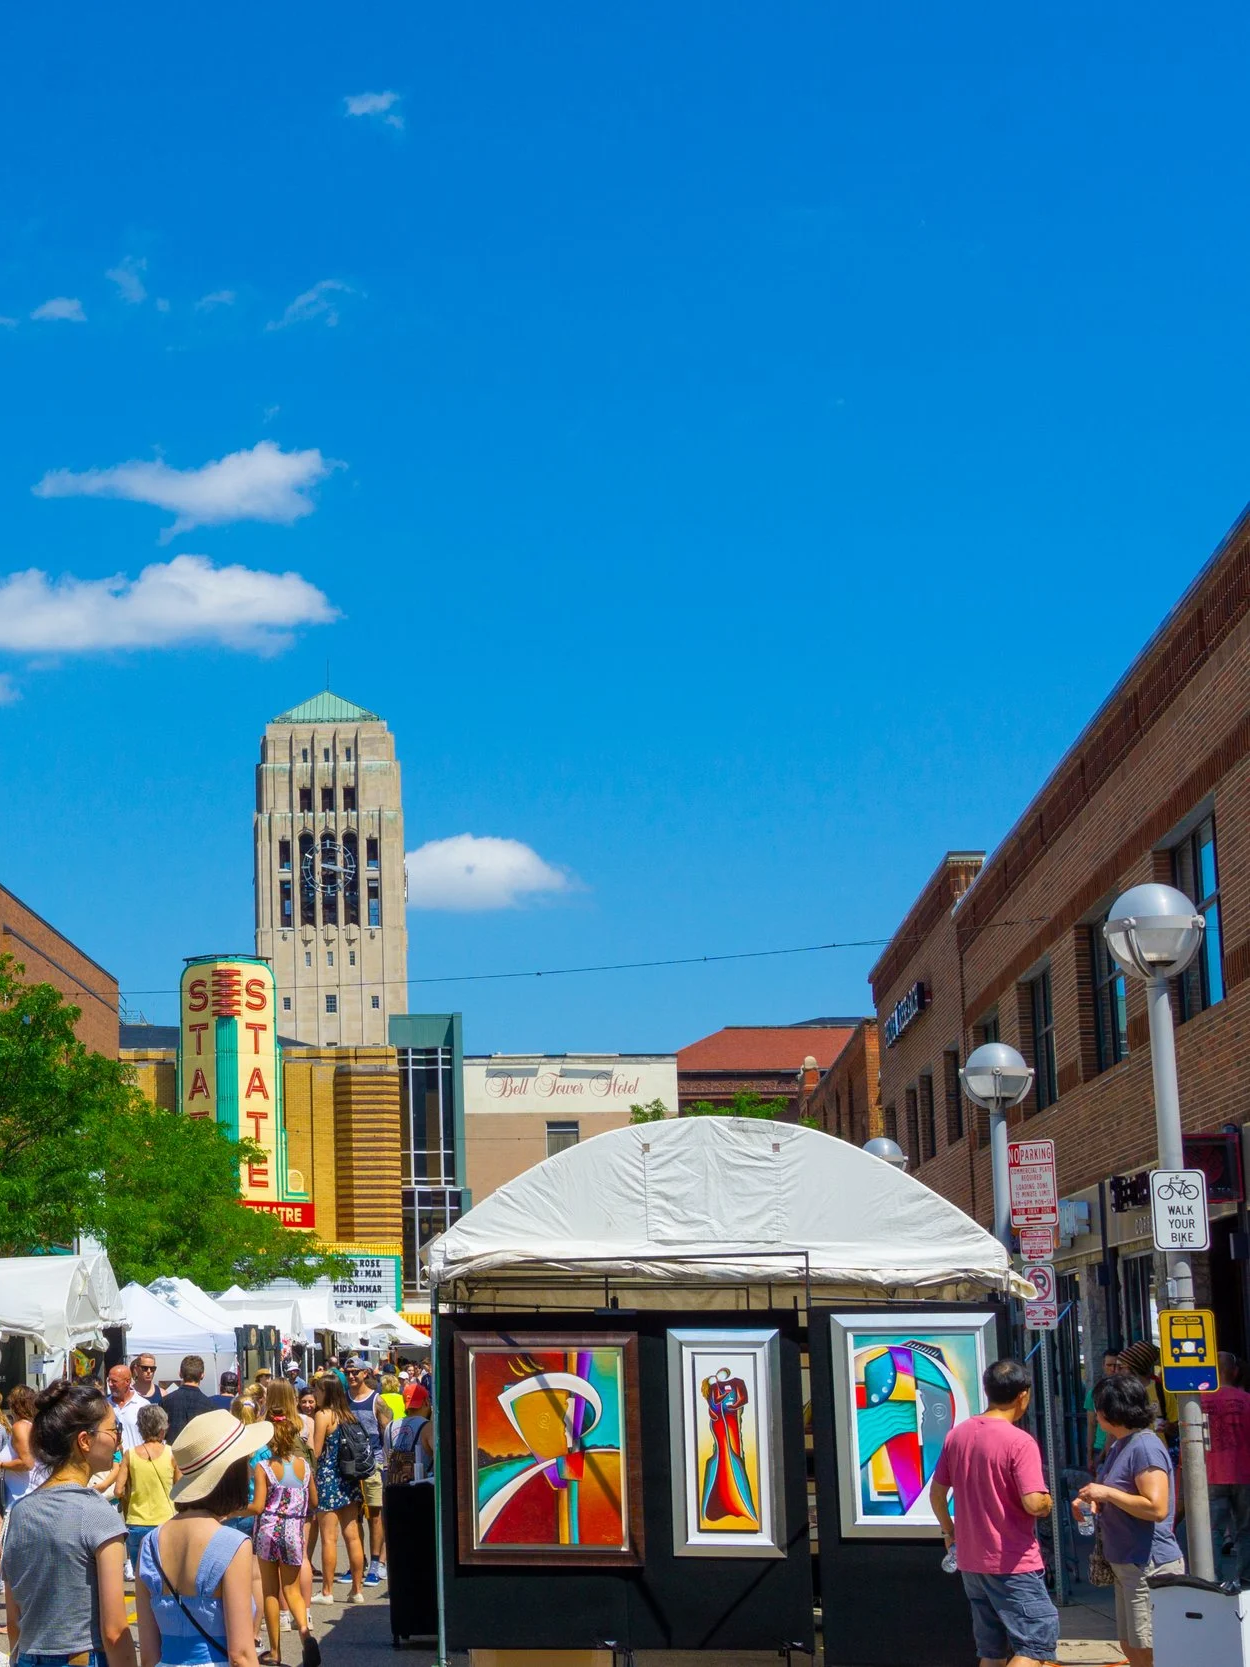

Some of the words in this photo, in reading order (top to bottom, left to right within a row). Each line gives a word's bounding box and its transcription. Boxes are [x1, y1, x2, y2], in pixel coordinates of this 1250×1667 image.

[189, 979, 210, 1120] STA
[245, 979, 269, 1188] STATE
[485, 1072, 528, 1098] Bell
[534, 1072, 584, 1098] Tower
[589, 1071, 640, 1098] Hotel
[1008, 1148, 1019, 1164] NO
[1020, 1147, 1051, 1161] PARKING
[1011, 1166, 1038, 1175] COMMERCIAL
[1039, 1165, 1052, 1173] PLATE
[1016, 1183, 1035, 1191] LOADING
[1021, 1190, 1037, 1198] MINUTE
[246, 1205, 302, 1222] ATRE
[1168, 1205, 1194, 1216] WALK
[1168, 1218, 1195, 1229] YOUR
[1171, 1232, 1194, 1243] BIKE
[359, 1259, 380, 1267] ROSE
[333, 1285, 382, 1293] MIDSOMMAR
[356, 1300, 378, 1309] NIGHT
